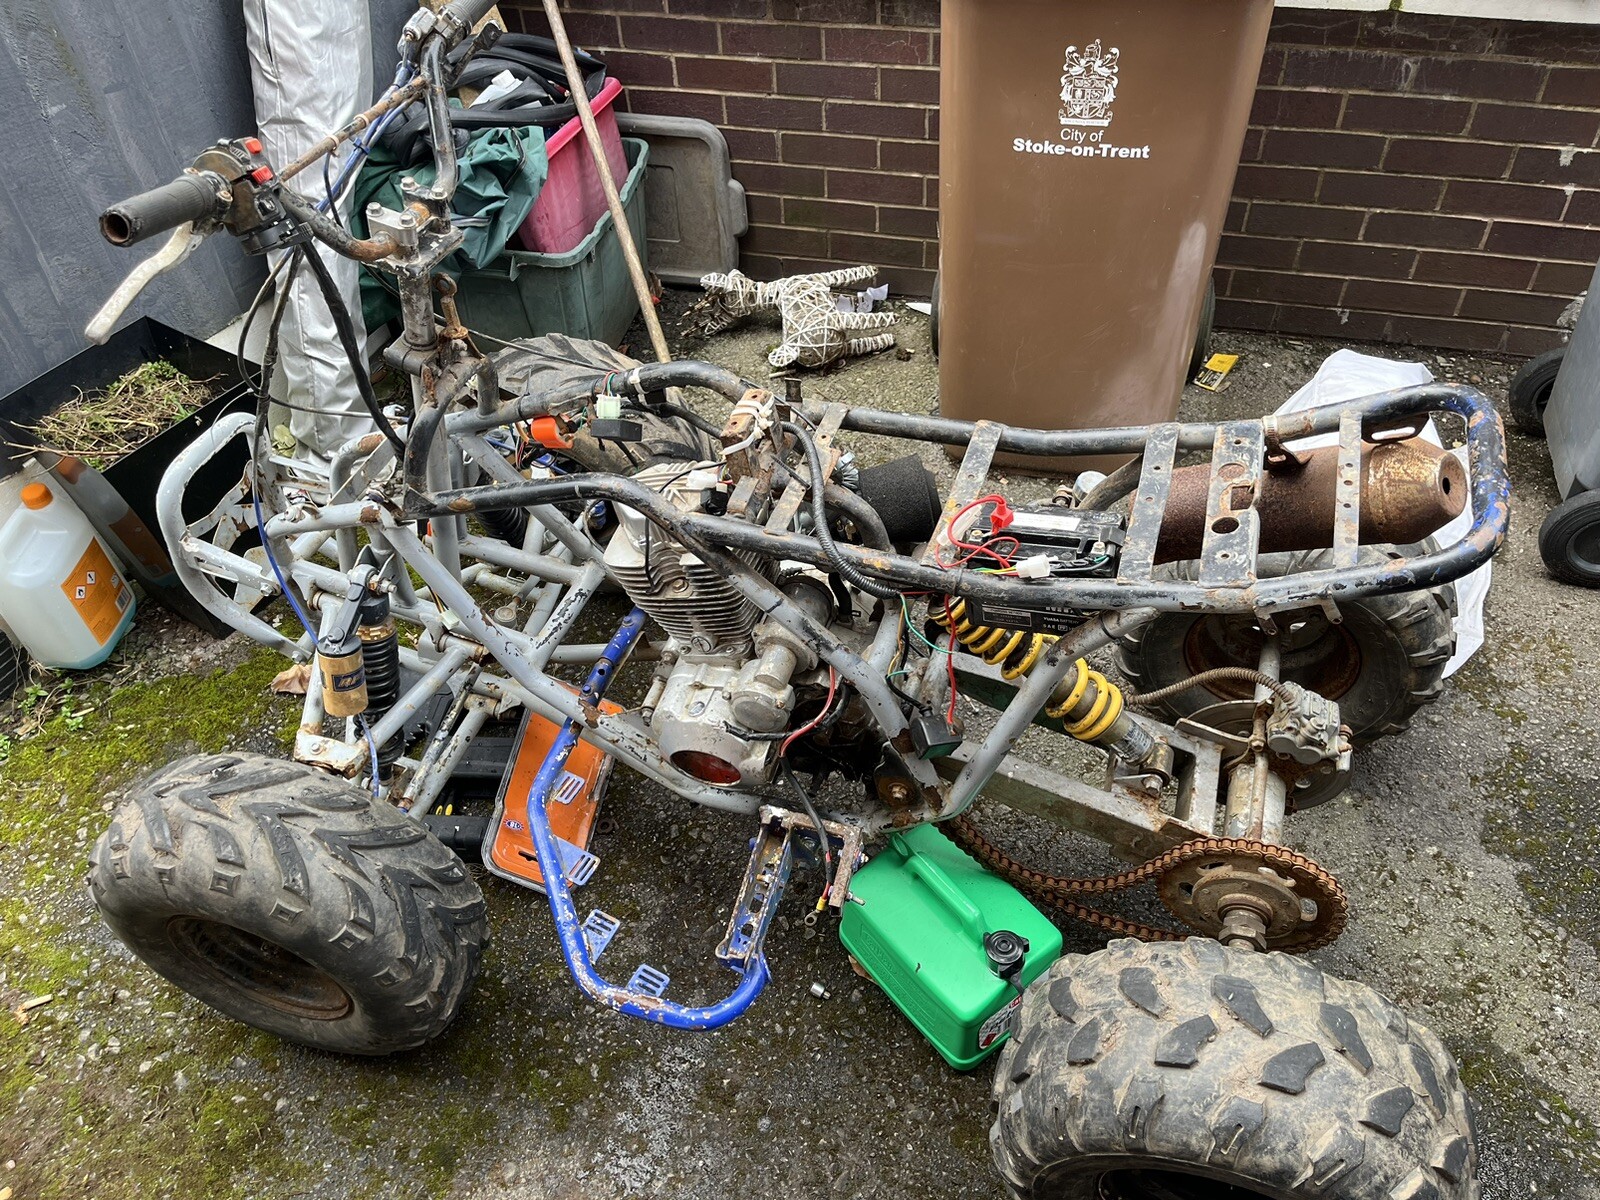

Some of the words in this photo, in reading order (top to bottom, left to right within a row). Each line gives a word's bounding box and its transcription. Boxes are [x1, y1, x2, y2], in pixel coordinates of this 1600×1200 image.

[1060, 128, 1086, 144] City
[1089, 129, 1105, 142] of
[1013, 138, 1150, 159] Stoke-on-Trent
